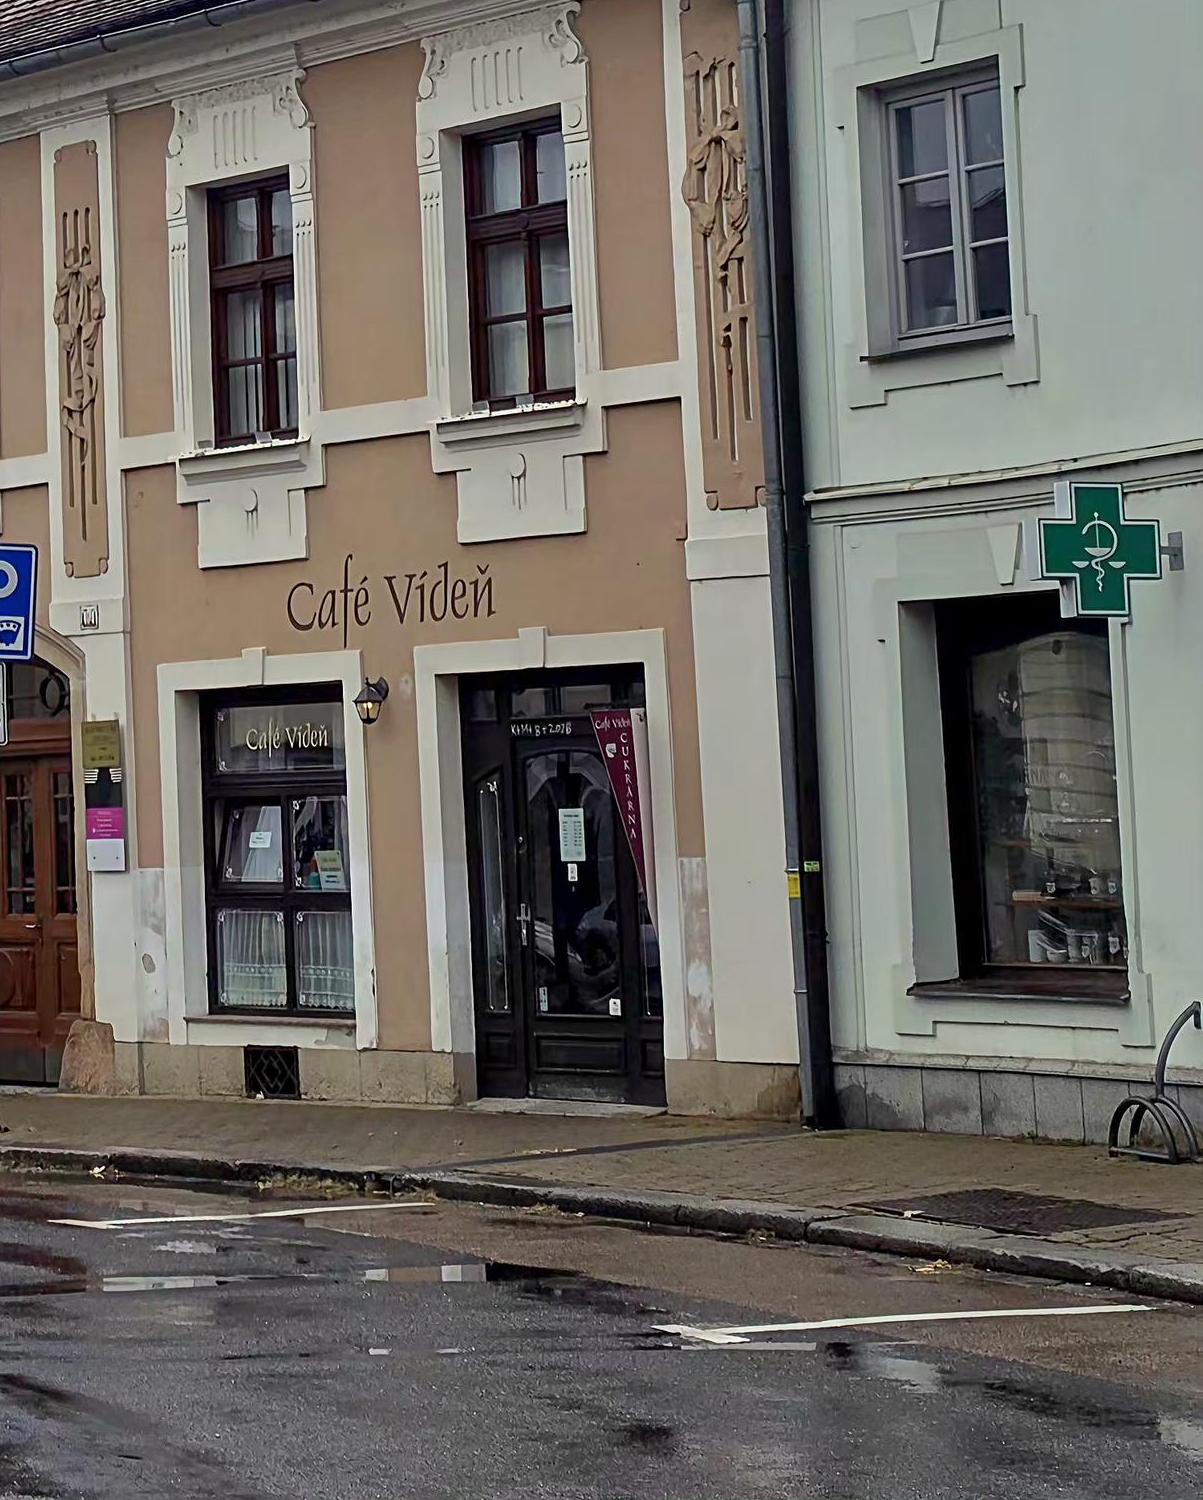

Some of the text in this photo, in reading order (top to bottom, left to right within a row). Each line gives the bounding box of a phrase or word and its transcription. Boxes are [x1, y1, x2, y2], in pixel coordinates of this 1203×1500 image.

[287, 554, 497, 649] Café Vídeň
[246, 716, 328, 758] Café Vídeň
